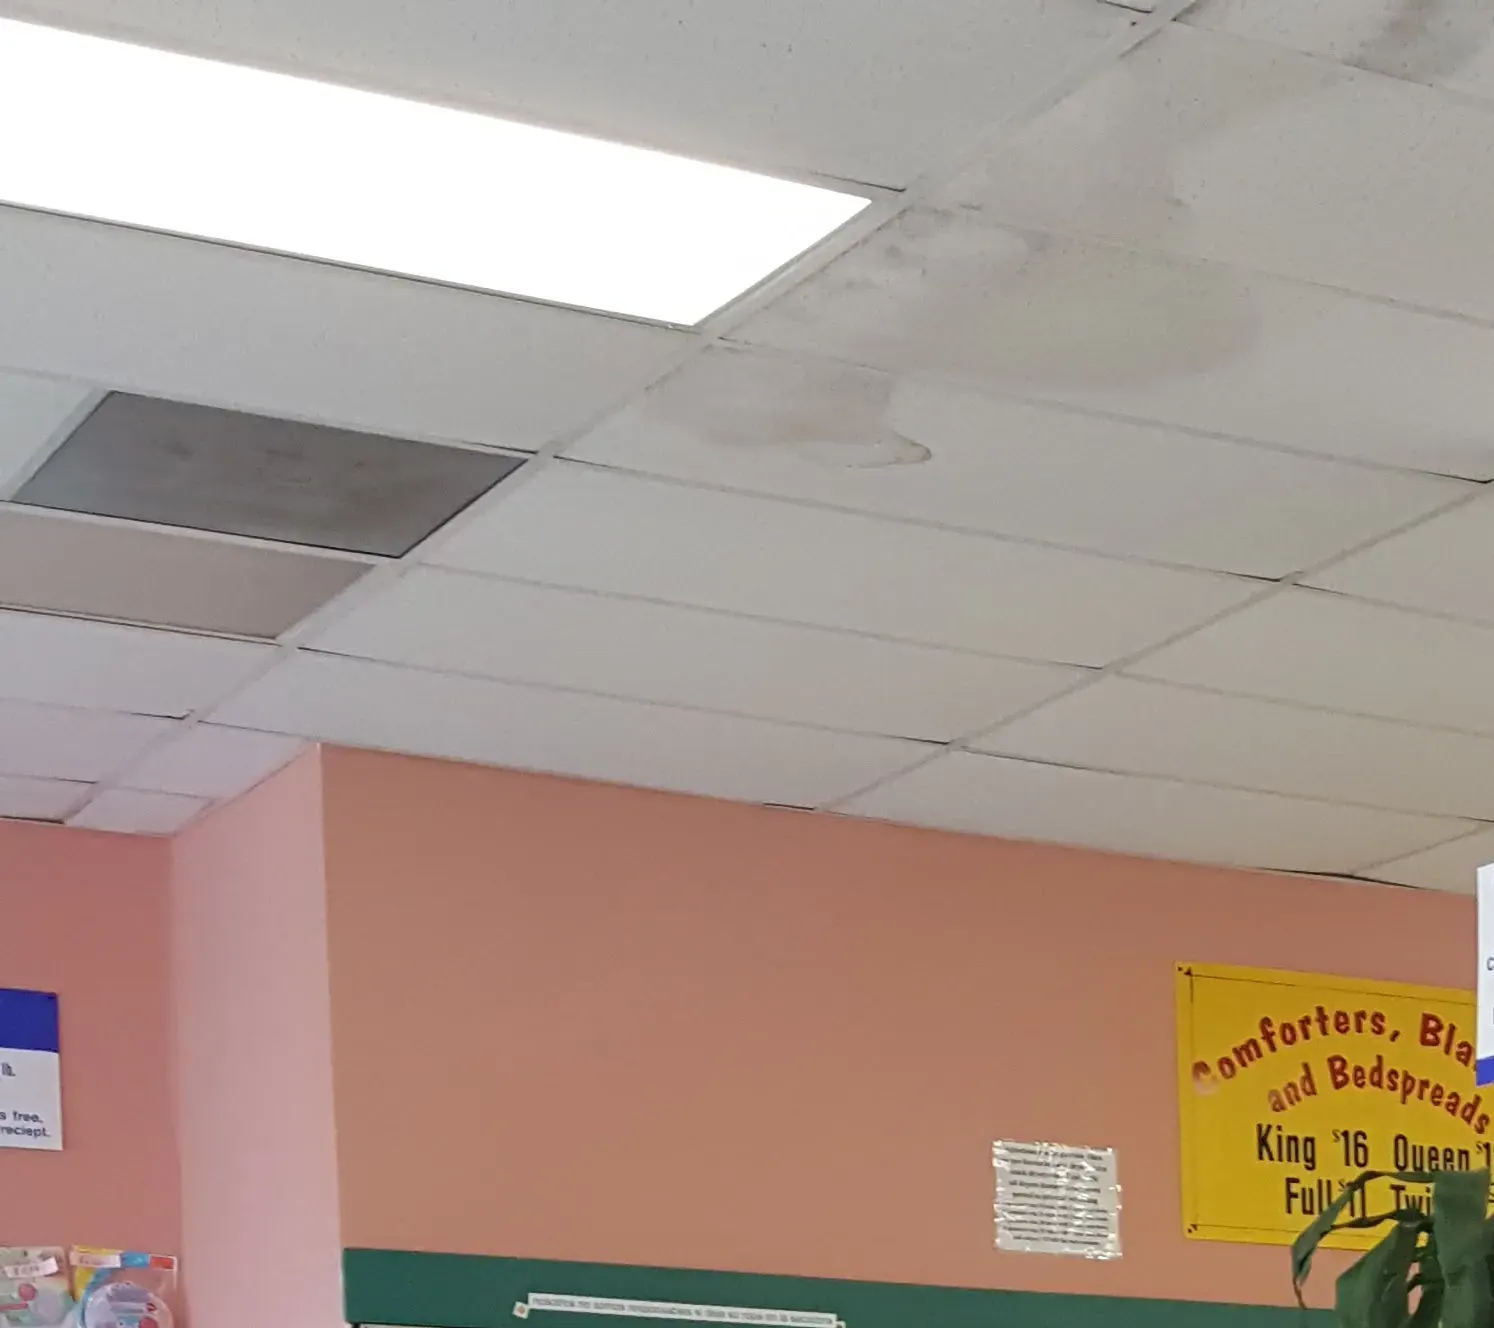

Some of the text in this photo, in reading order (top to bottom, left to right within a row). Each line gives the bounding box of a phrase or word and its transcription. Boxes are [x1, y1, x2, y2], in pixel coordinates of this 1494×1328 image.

[1192, 1005, 1400, 1096] Comforters,
[12, 1110, 44, 1124] free.
[1268, 1054, 1490, 1134] and Bedspreads
[1257, 1123, 1315, 1170] King
[1332, 1129, 1369, 1168] $16
[1394, 1134, 1470, 1172] Queen
[1285, 1177, 1332, 1215] Full
[1390, 1185, 1432, 1216] Twi
